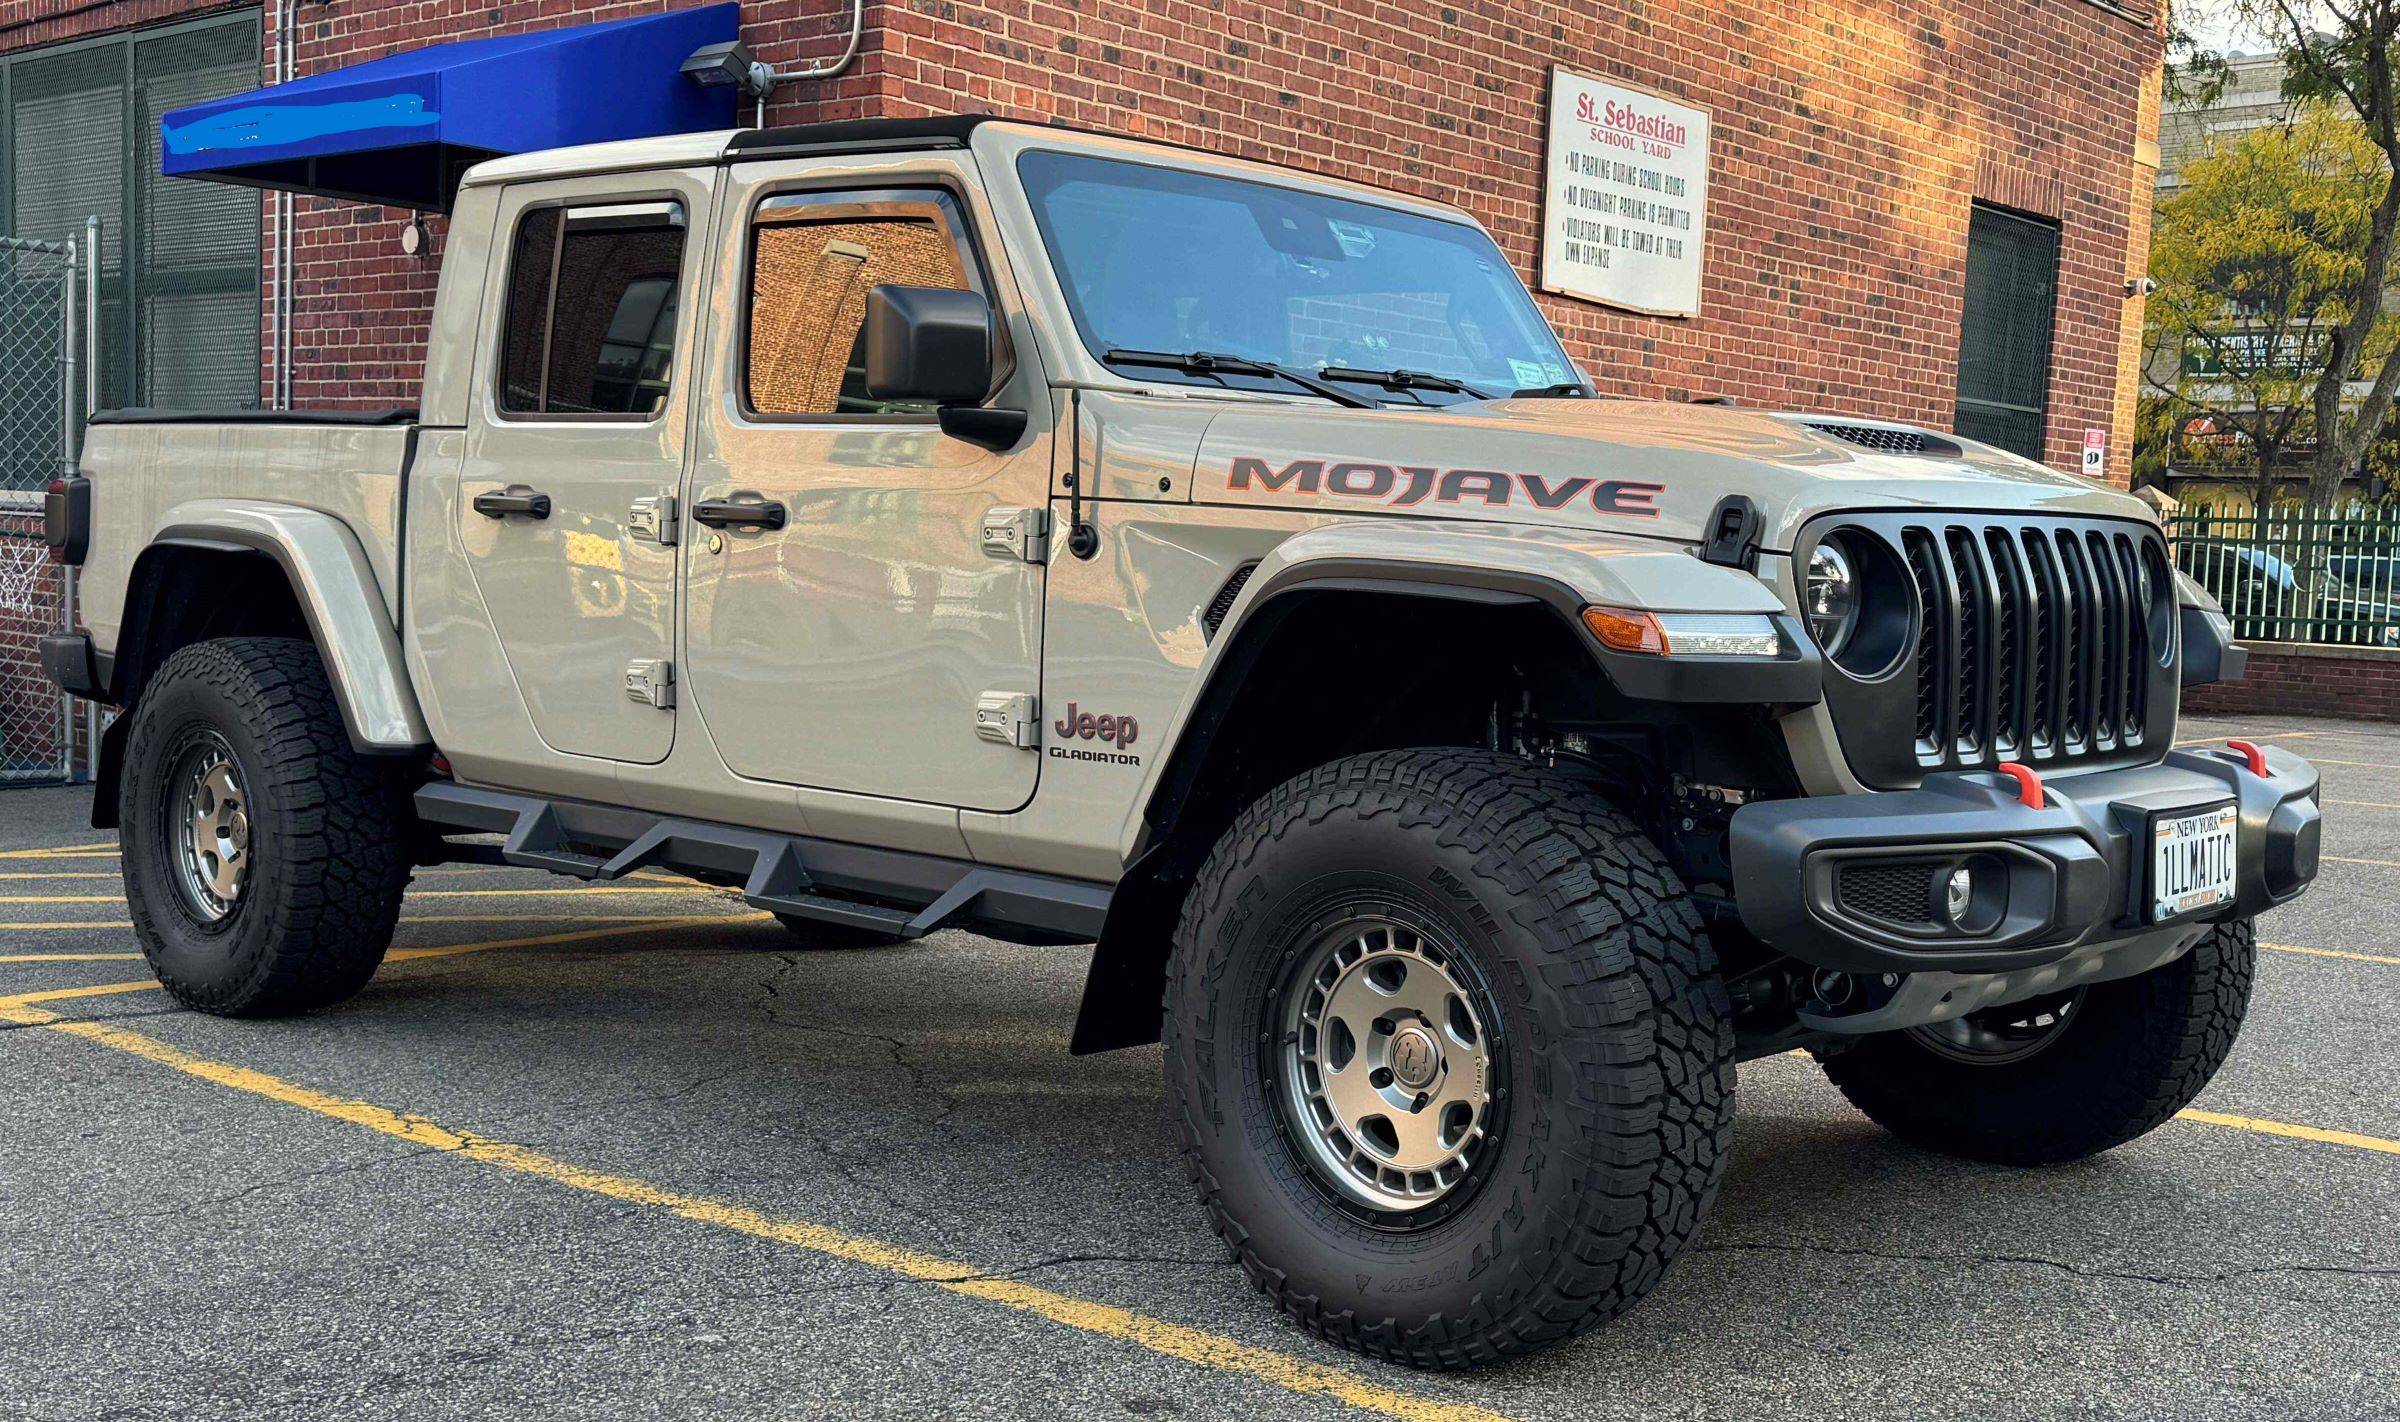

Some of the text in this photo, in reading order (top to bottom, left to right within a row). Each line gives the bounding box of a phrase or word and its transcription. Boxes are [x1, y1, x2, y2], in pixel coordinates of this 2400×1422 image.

[1576, 91, 1686, 145] St. Sebastian
[1590, 128, 1672, 160] SCHOOL YARD
[1569, 151, 1685, 198] NO PARKING DURING SCHOOL HOURS
[1567, 185, 1691, 231] NO OVERNIGHT PARKING IS PERMITTED
[1565, 241, 1610, 269] OWN EXPENSE
[1566, 217, 1683, 260] VIOLATORS WILL BE TOWED AT THEIR
[1226, 456, 1667, 520] MOJAVE
[1055, 702, 1139, 750] Jeep
[1049, 746, 1141, 767] GLADIATOR
[2176, 815, 2219, 838] NEW YORK
